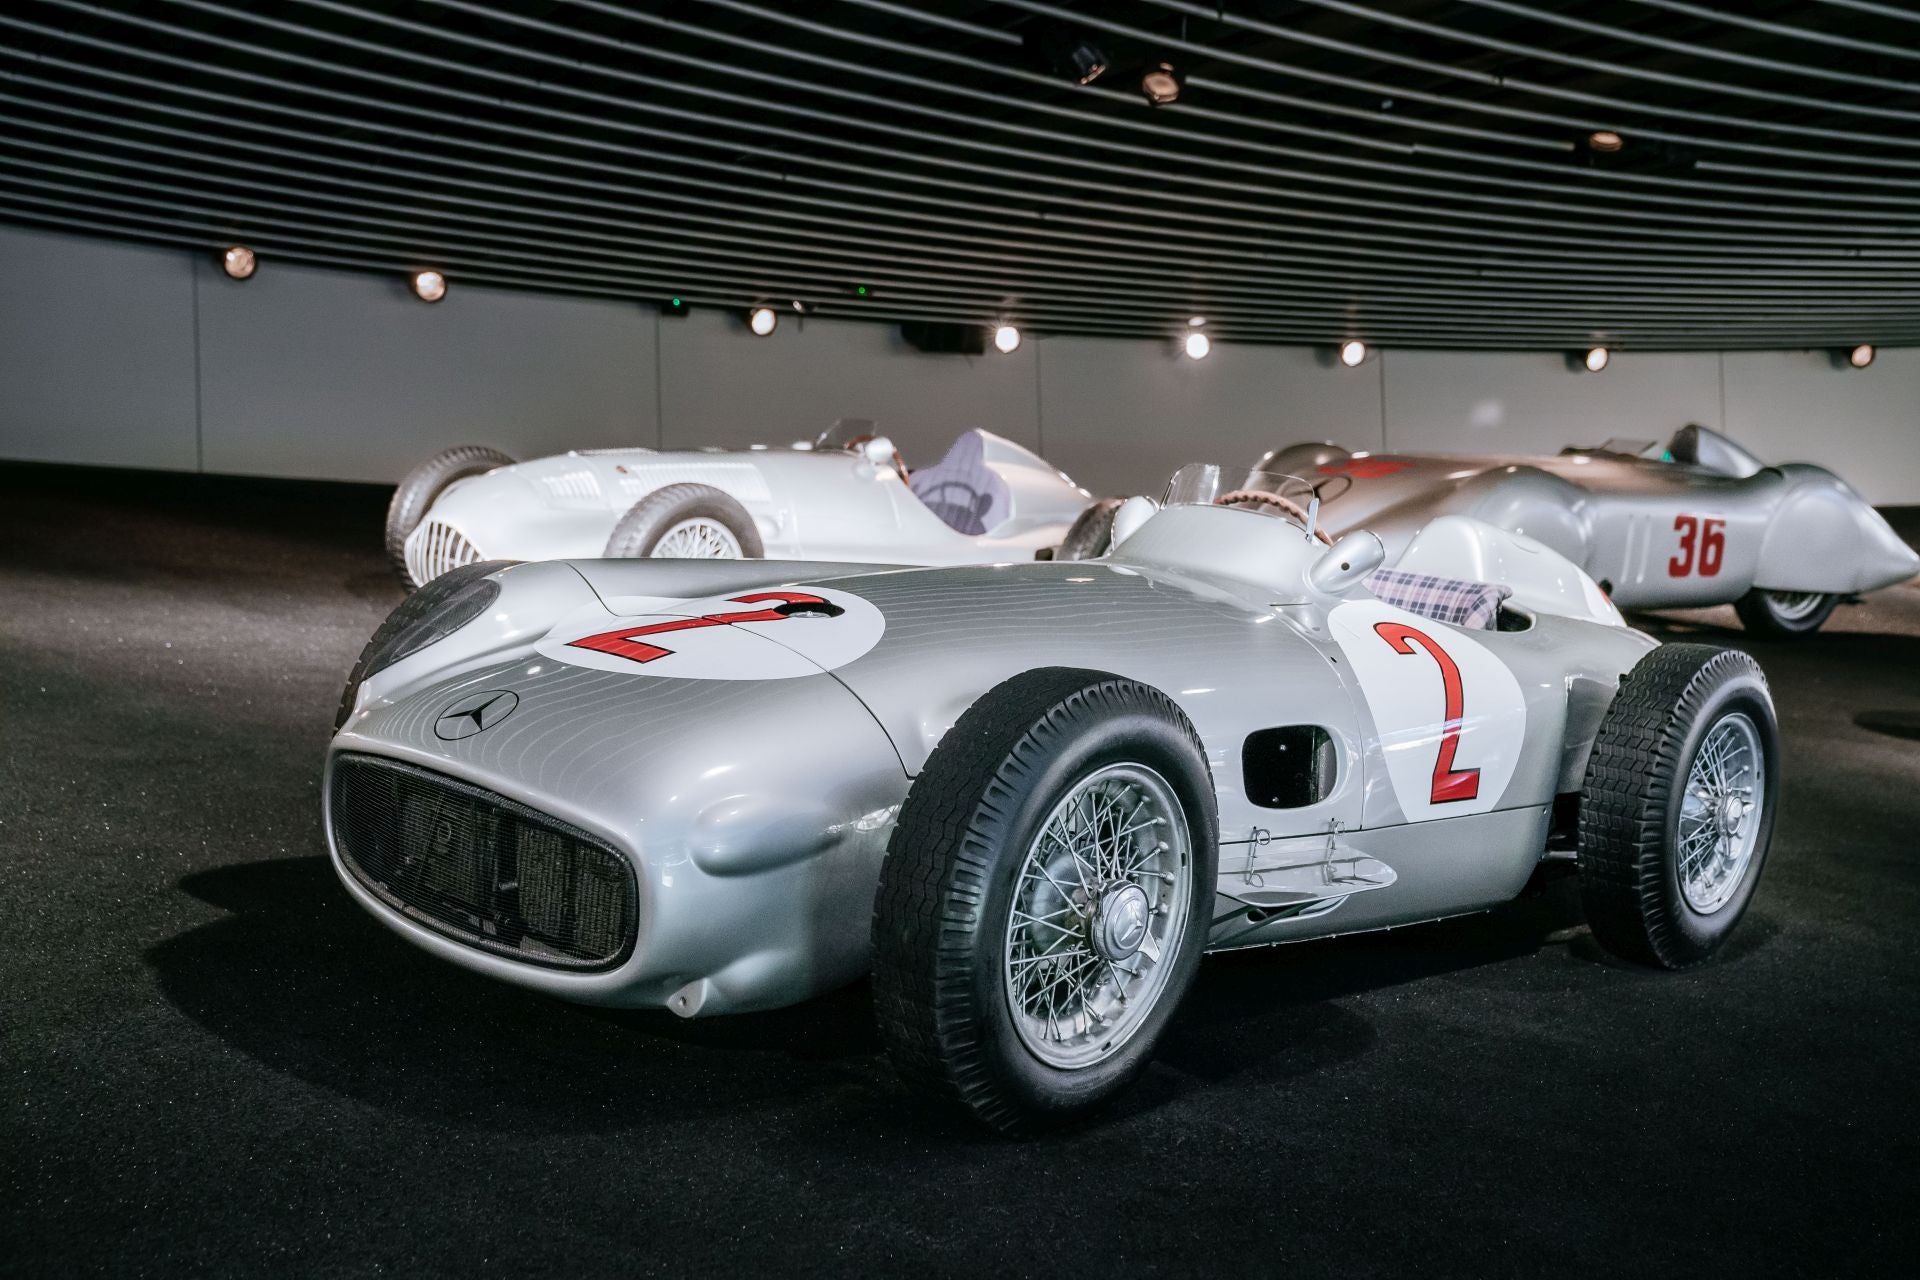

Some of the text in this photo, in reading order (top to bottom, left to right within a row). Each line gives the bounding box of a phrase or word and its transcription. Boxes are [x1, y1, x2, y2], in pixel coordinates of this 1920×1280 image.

[1668, 515, 1726, 578] 36
[564, 591, 831, 664] 2
[1373, 622, 1481, 805] 2
